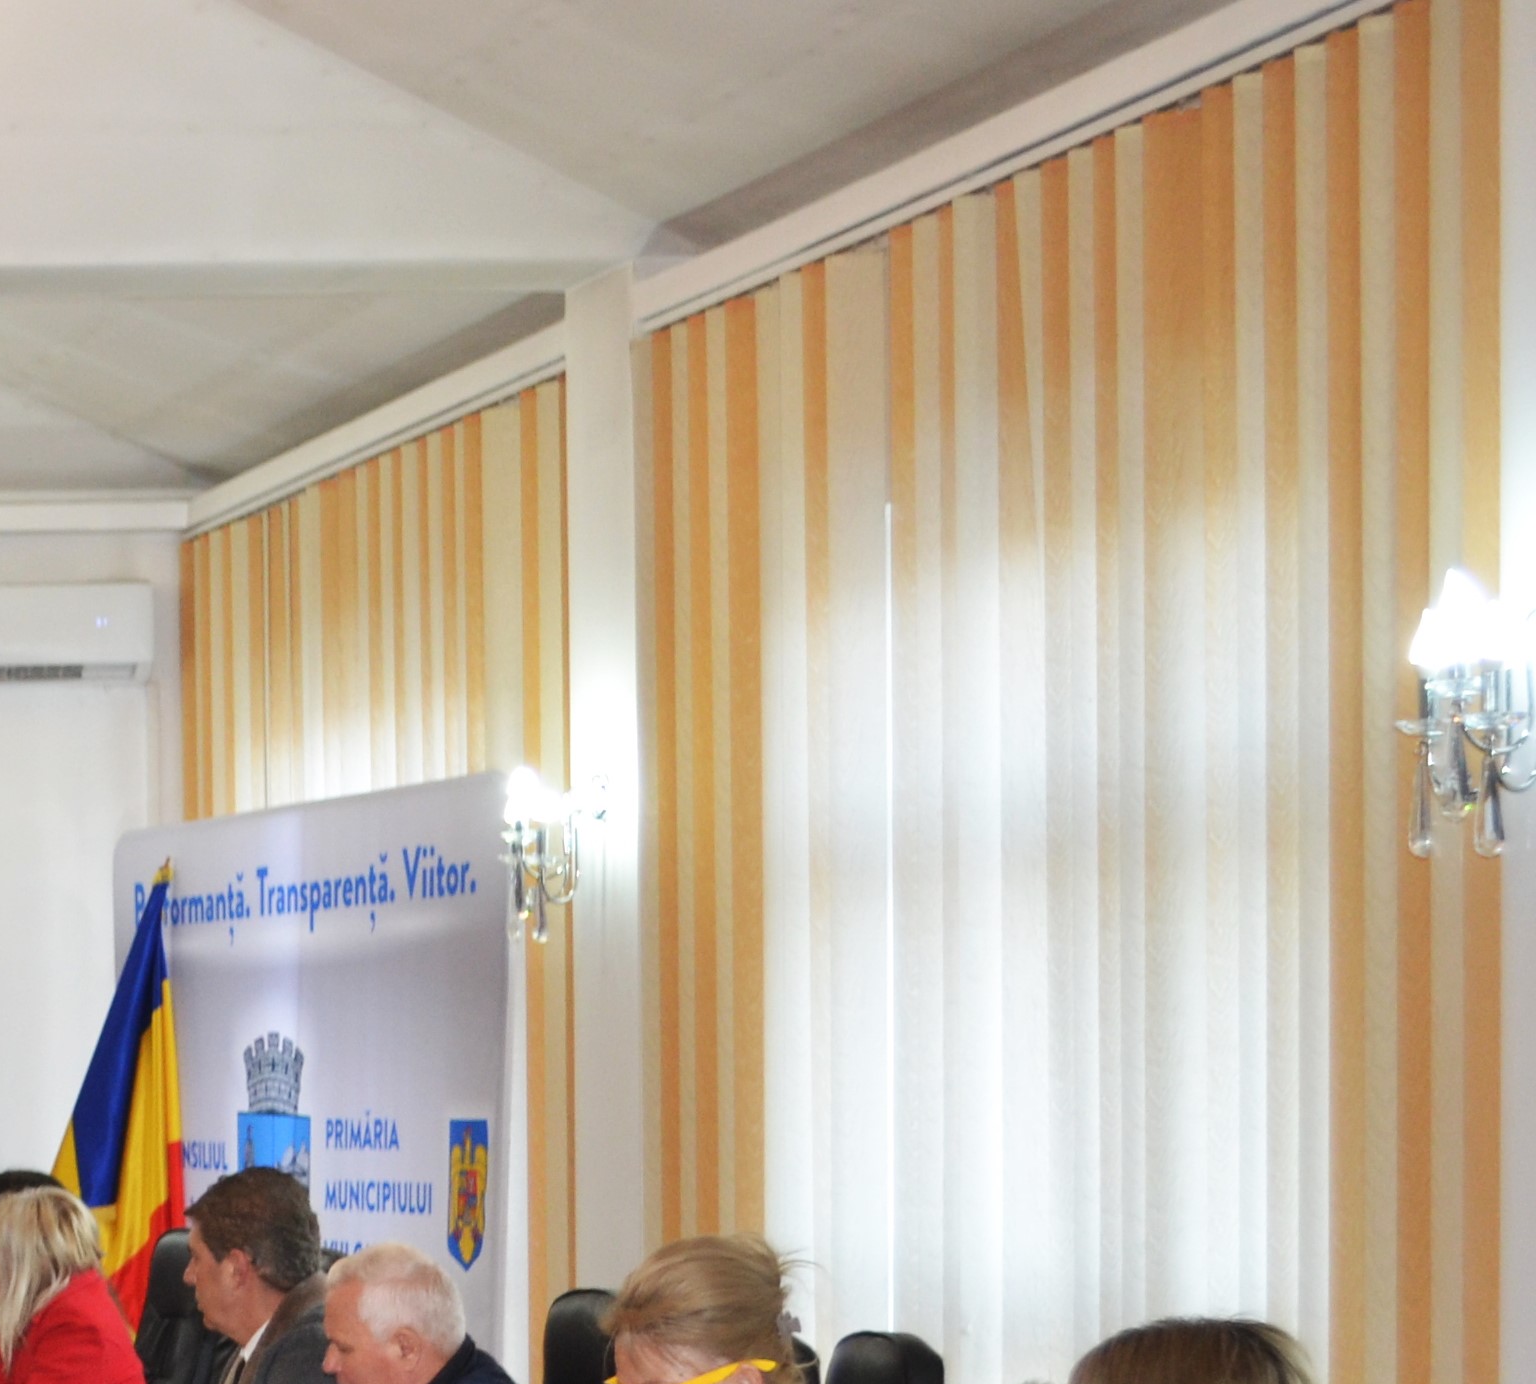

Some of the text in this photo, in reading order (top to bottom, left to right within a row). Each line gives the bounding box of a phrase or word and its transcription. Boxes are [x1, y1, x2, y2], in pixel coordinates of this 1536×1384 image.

[256, 852, 396, 933] Transparență.
[402, 845, 477, 900] Viitor.
[325, 1109, 401, 1151] PRIMĂRIA
[182, 1140, 228, 1171] NSILIUL
[324, 1180, 433, 1214] MUNICIPIULUI
